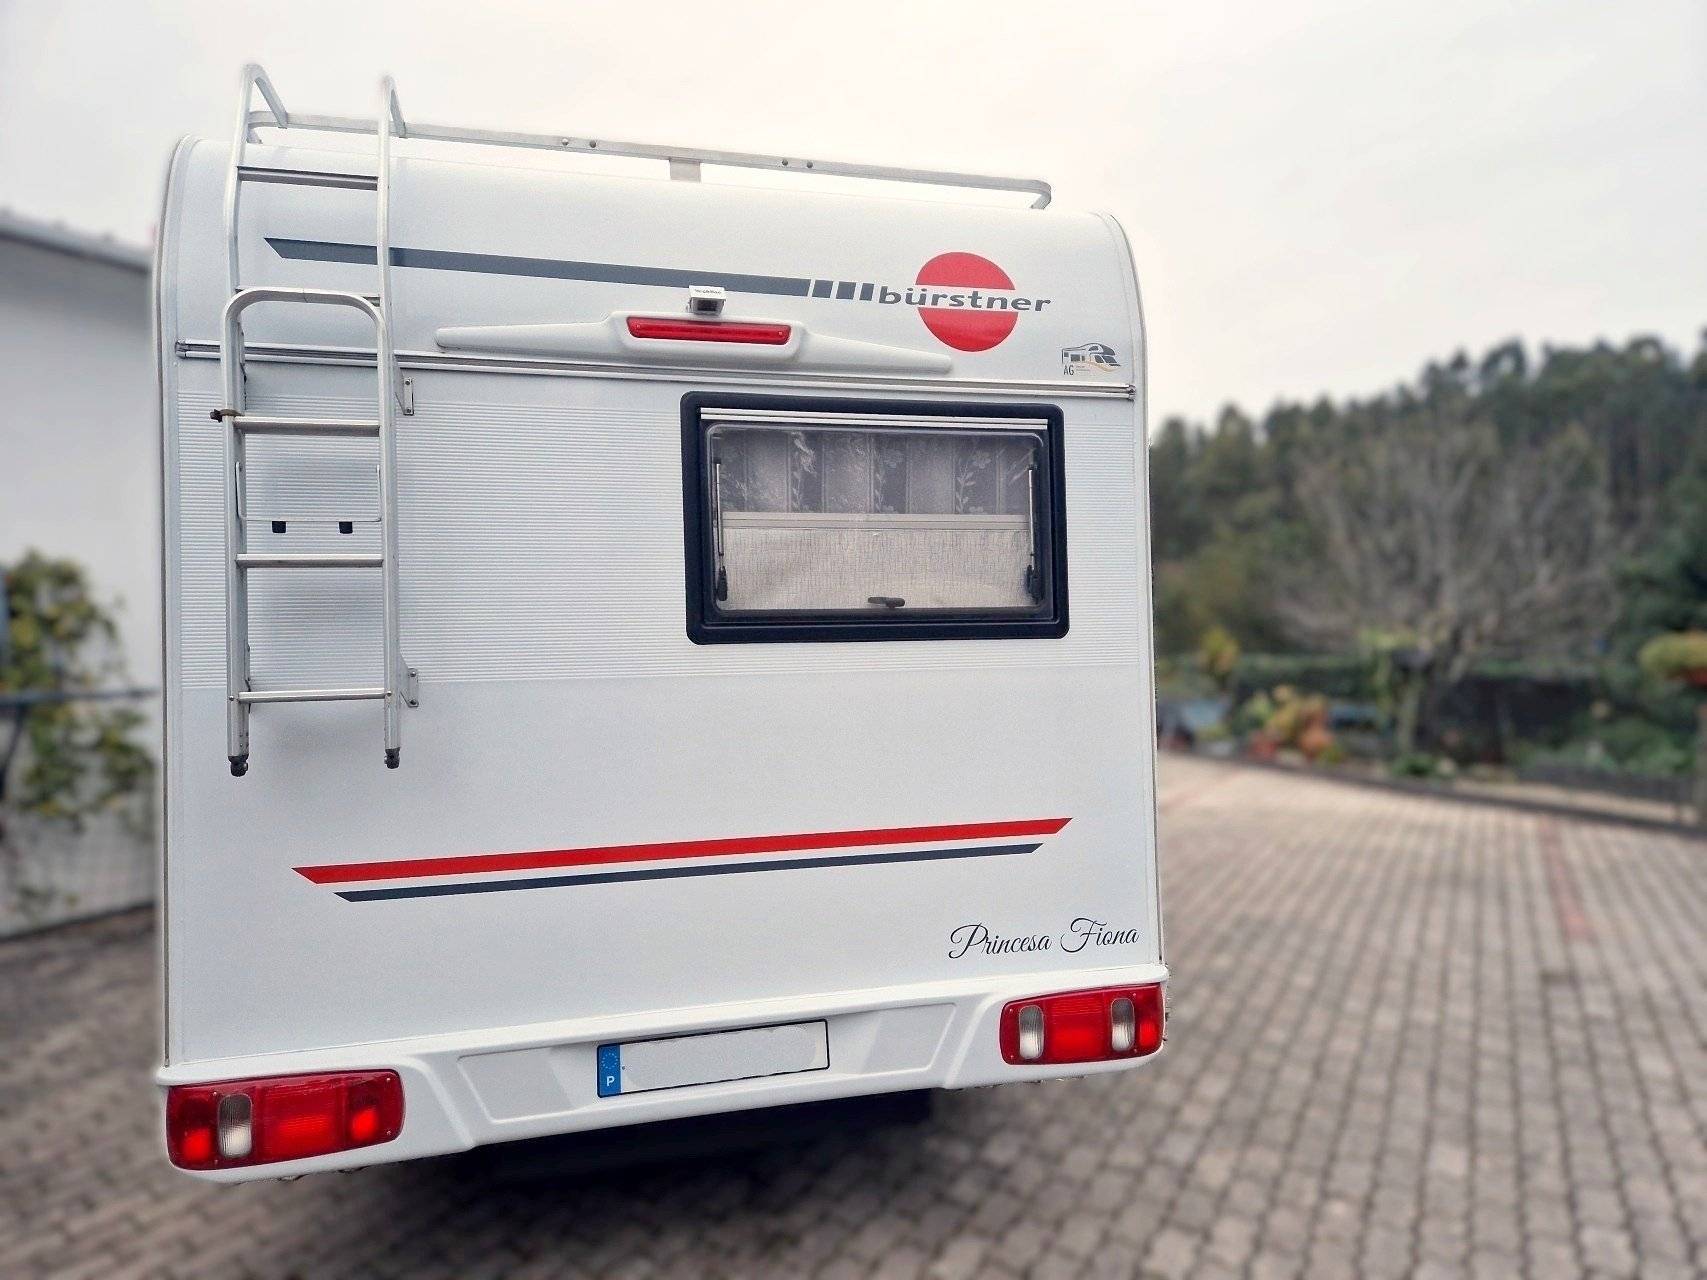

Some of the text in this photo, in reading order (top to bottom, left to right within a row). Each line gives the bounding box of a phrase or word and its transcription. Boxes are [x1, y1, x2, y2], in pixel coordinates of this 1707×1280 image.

[879, 286, 1051, 311] bürstner
[1063, 364, 1075, 376] AG
[948, 917, 1140, 959] Princesa Fiona
[606, 1075, 615, 1087] P
